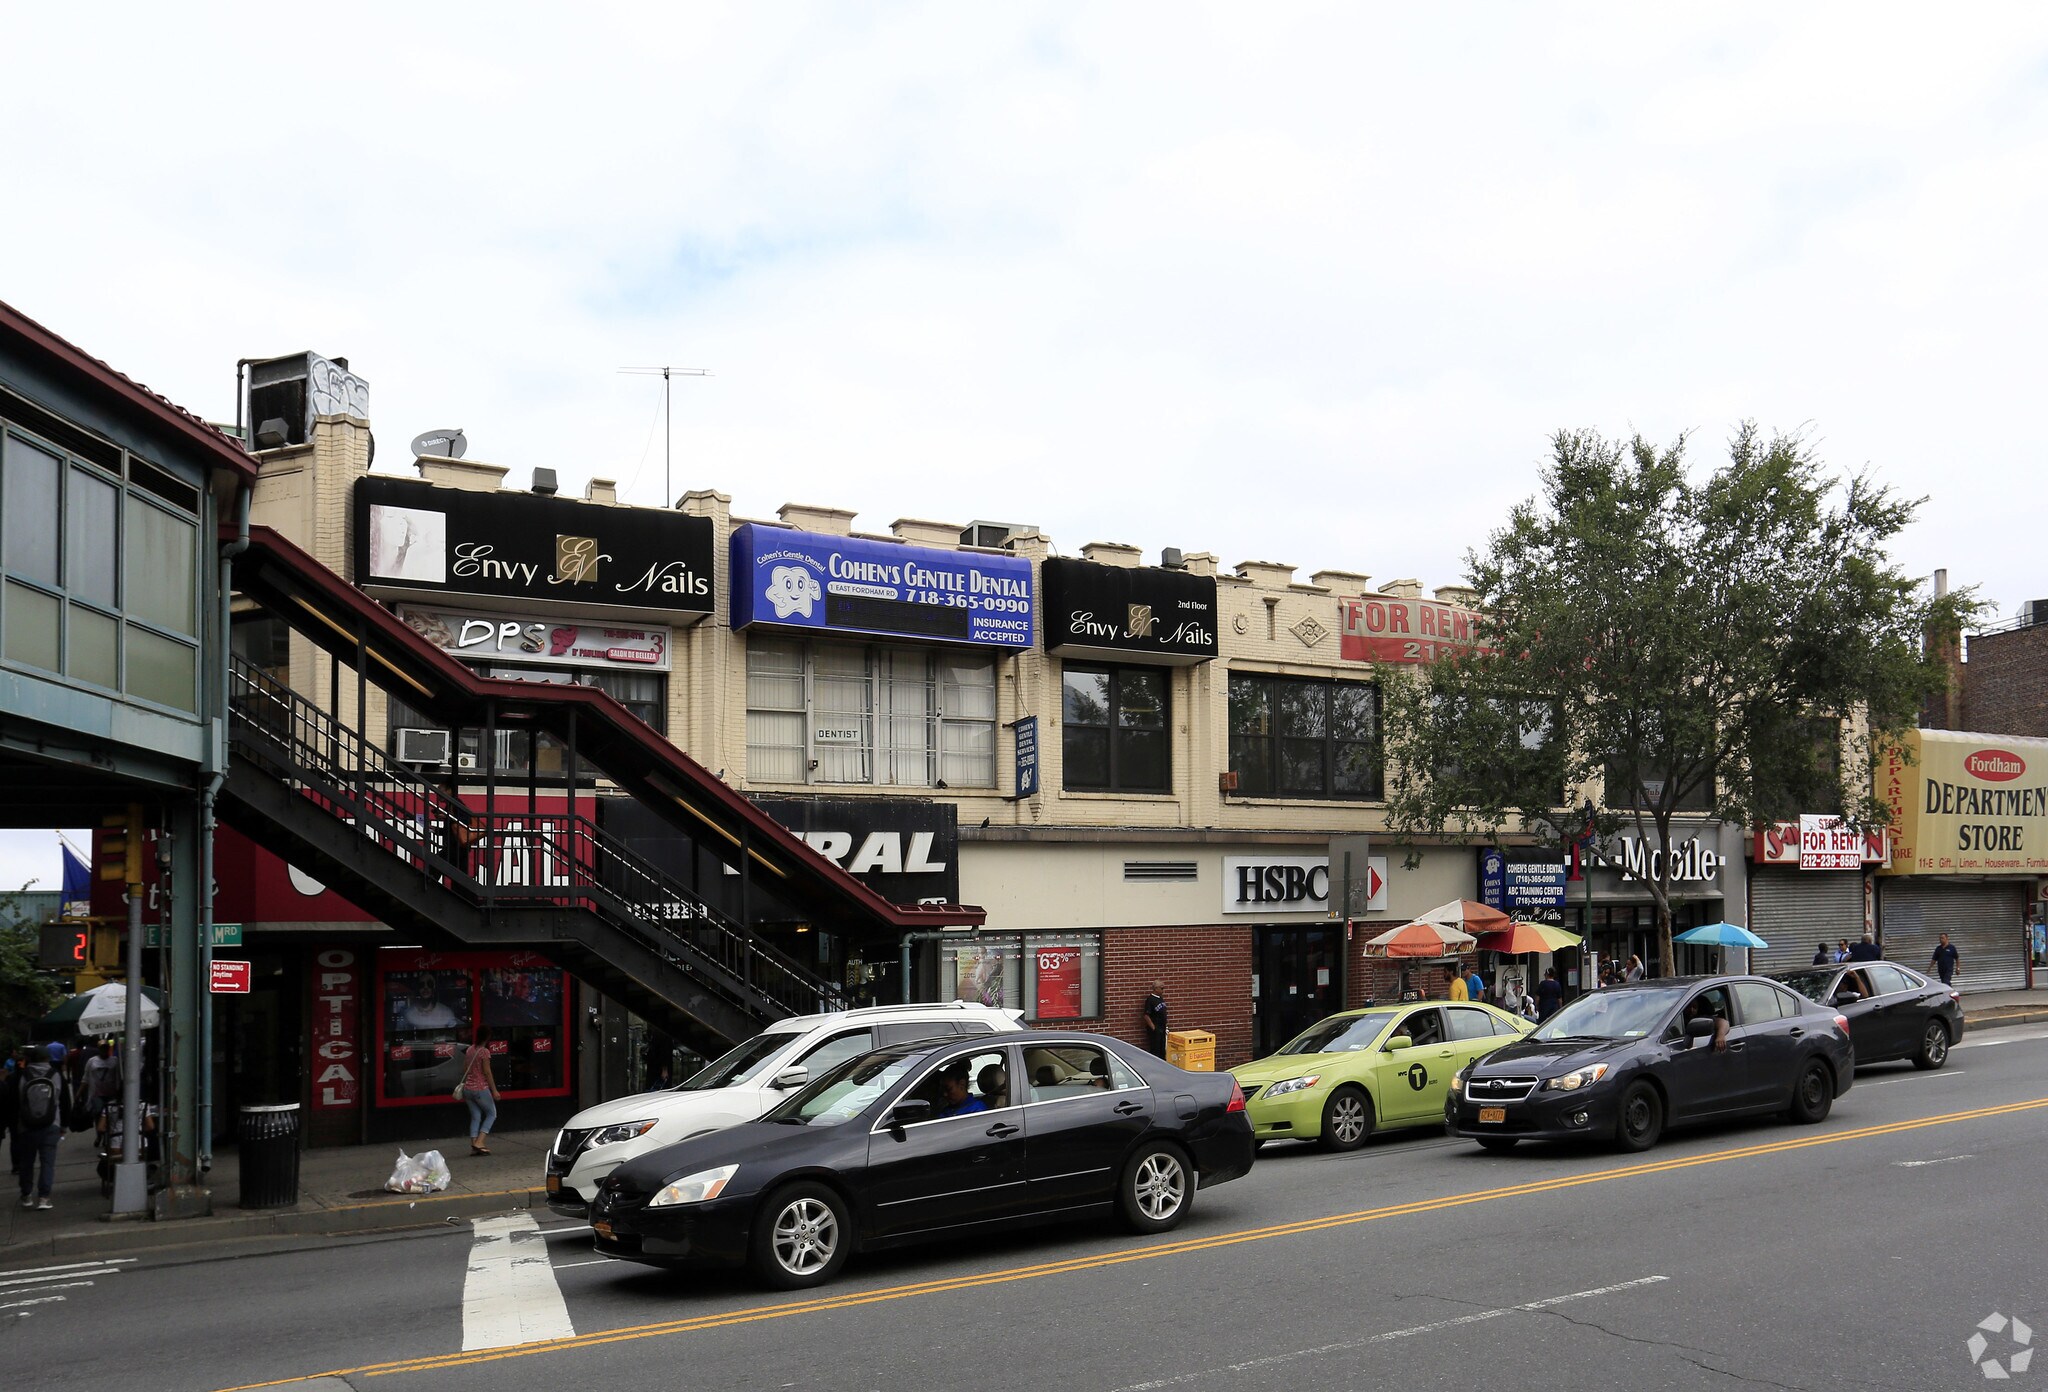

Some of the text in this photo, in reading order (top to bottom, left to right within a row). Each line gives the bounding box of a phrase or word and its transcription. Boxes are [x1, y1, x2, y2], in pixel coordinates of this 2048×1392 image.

[453, 542, 538, 586] Envy
[615, 561, 709, 596] Nails
[757, 550, 826, 572] Cohen's Gentle Dental
[903, 562, 965, 593] GENTLE
[969, 569, 1030, 599] DENTAL
[852, 586, 885, 596] FORDHAM
[906, 588, 1029, 614] 718-365-0990
[1178, 600, 1208, 611] 2nd Floor
[973, 617, 1029, 631] INSURANCE
[1070, 610, 1118, 640] Envy
[1159, 621, 1213, 646] Nails
[1348, 601, 1484, 641] FOR RENT
[458, 618, 546, 653] DPS
[973, 630, 1025, 643] ACCEPTED
[610, 649, 657, 660] SALON DE BELLEZA
[818, 729, 858, 739] DENTIST
[1970, 755, 2021, 774] Fordham
[1925, 777, 2048, 817] DEPARTMEN
[1803, 832, 1860, 851] FOR RENT
[1958, 823, 2024, 851] STORE
[1507, 864, 1564, 874] COHEN'S GENTLE DENTAL
[1802, 854, 1859, 868] 212-239-8580
[1236, 865, 1329, 902] HSBC
[1507, 886, 1564, 896] ABC TRAINING CENTER
[1510, 909, 1534, 921] Envy
[1535, 908, 1562, 921] Nails
[74, 933, 87, 960] 2
[1040, 952, 1069, 969] 63%
[317, 950, 355, 1105] OPTICAL
